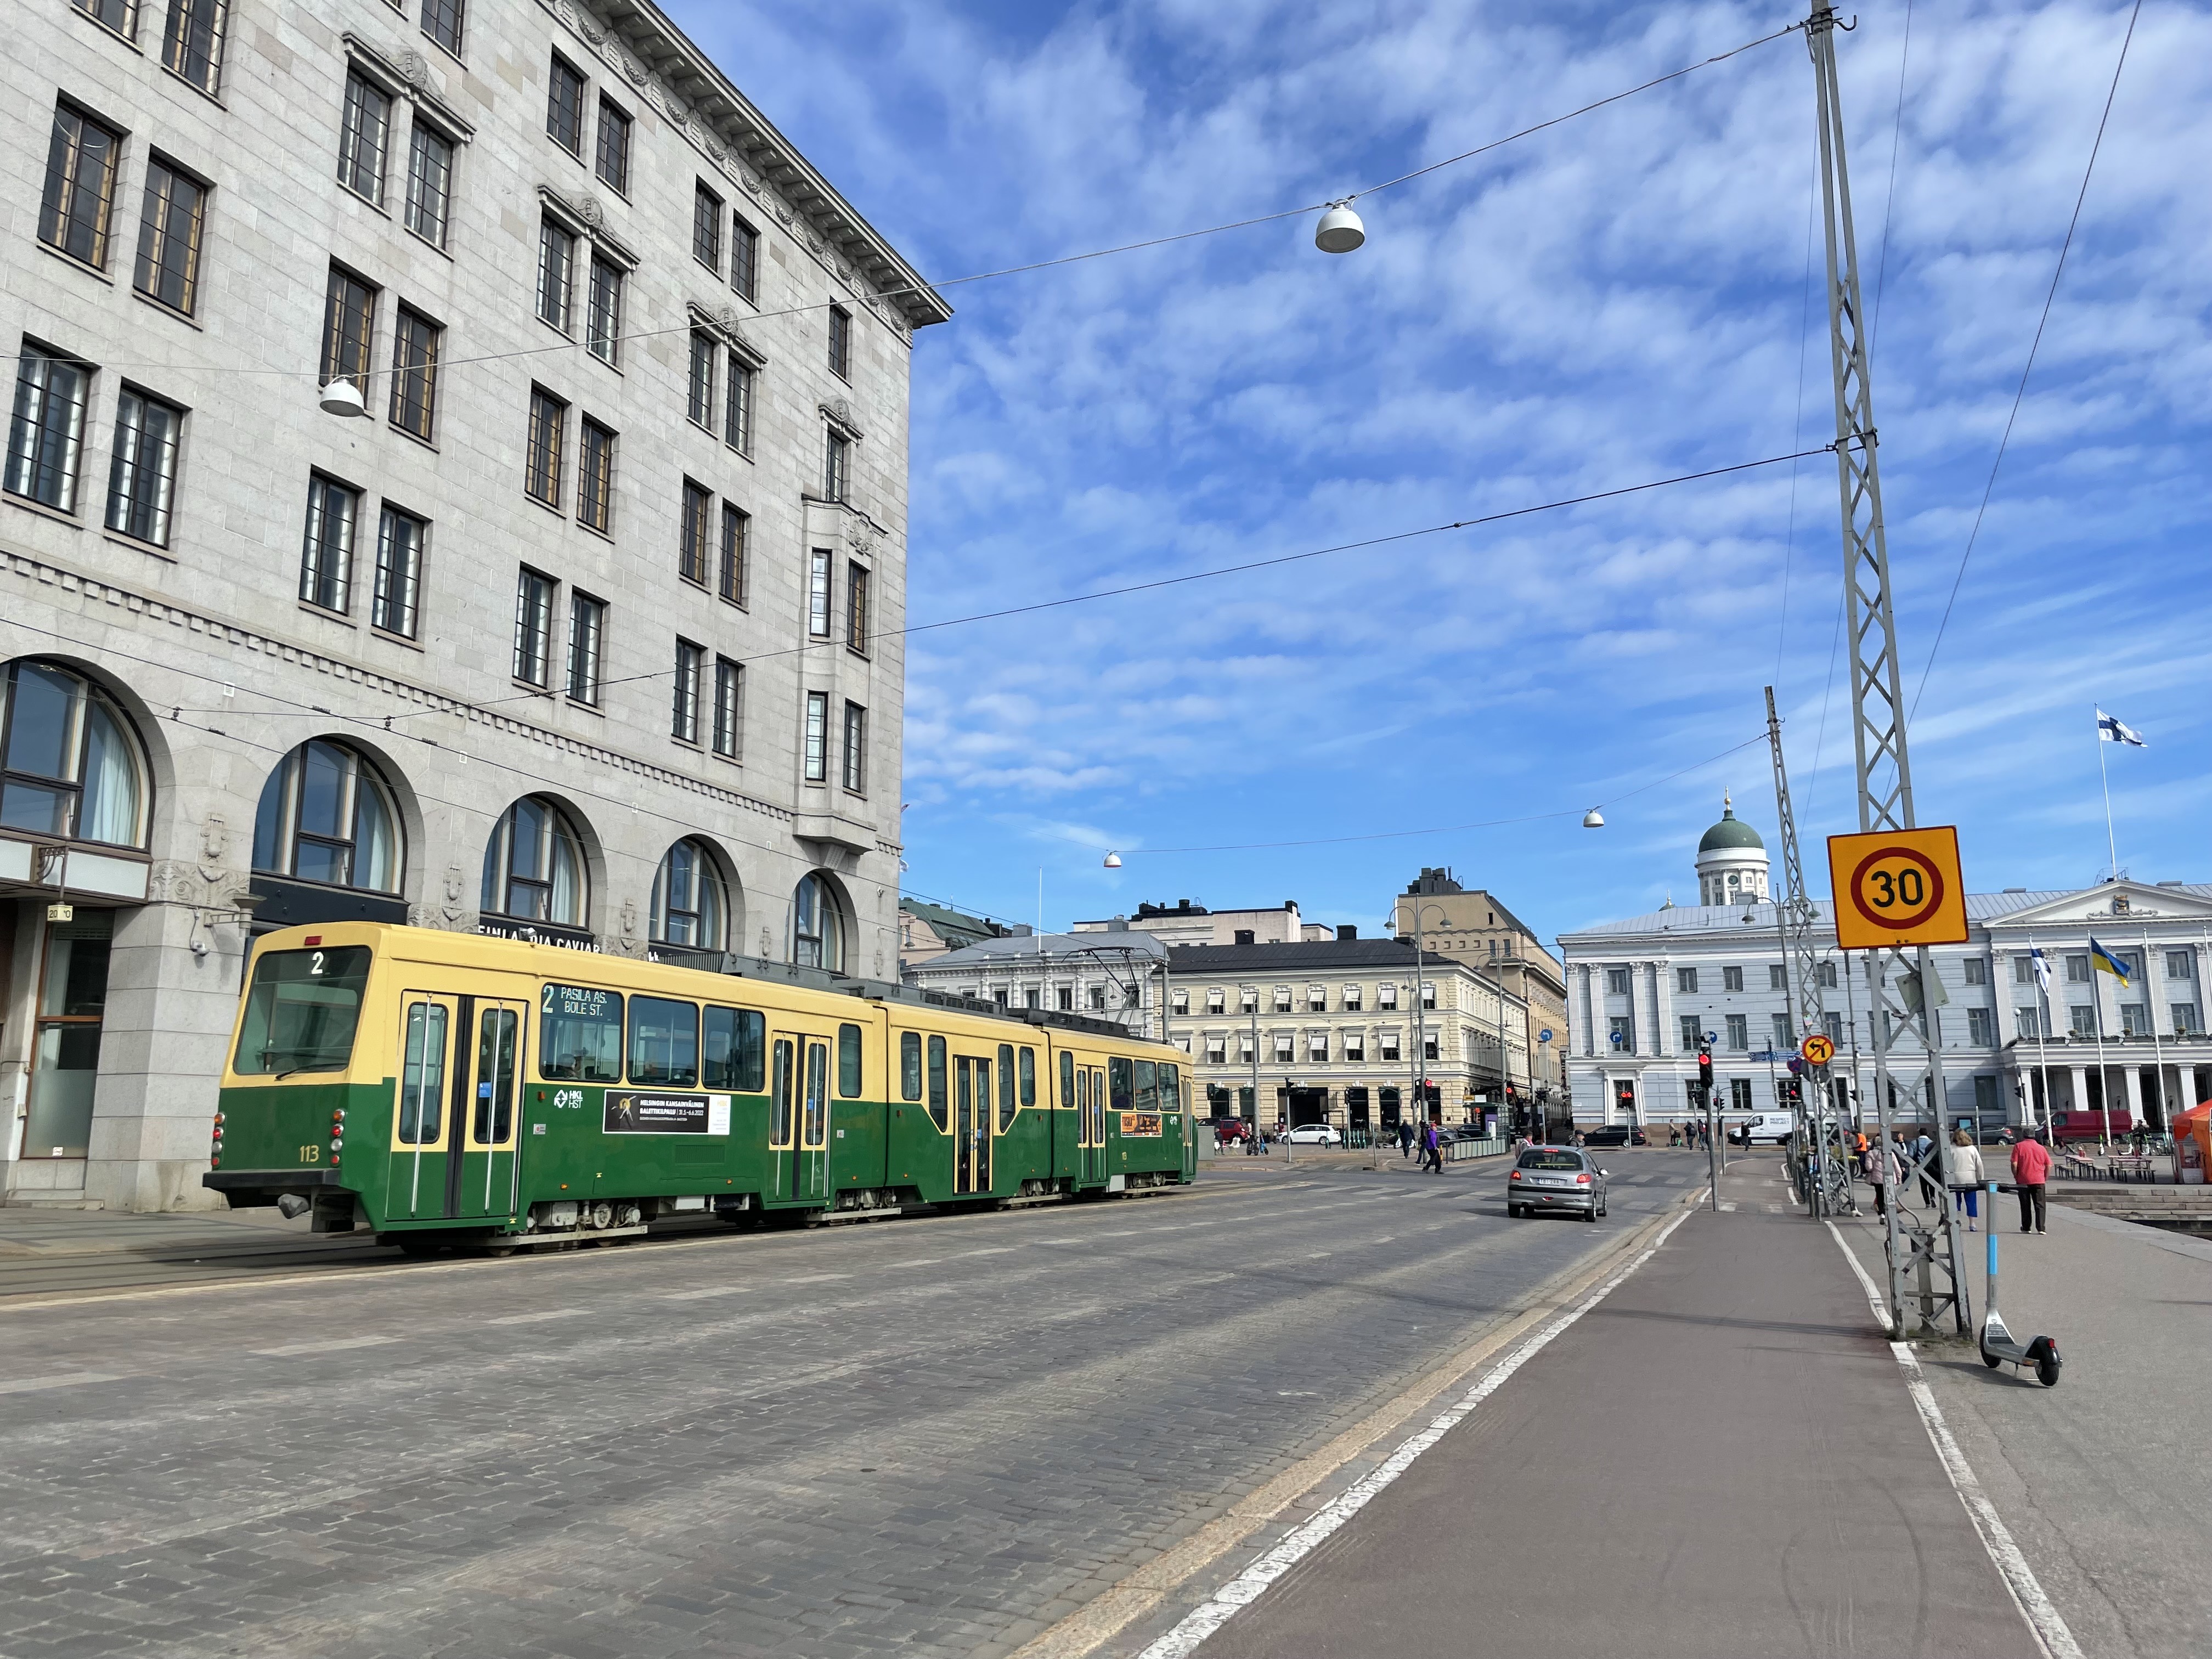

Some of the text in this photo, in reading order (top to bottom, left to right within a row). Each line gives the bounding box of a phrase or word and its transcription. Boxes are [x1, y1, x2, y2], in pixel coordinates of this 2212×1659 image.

[1871, 868, 1923, 907] 30
[49, 910, 58, 918] 20
[478, 925, 600, 953] FINLADIA CAVIAR
[311, 951, 324, 974] 2
[542, 985, 554, 1013] 2
[561, 987, 607, 1004] PASILA AS.
[589, 1004, 603, 1016] ST.
[569, 1090, 583, 1099] HKL
[568, 1099, 583, 1108] HST
[300, 1145, 319, 1162] 113
